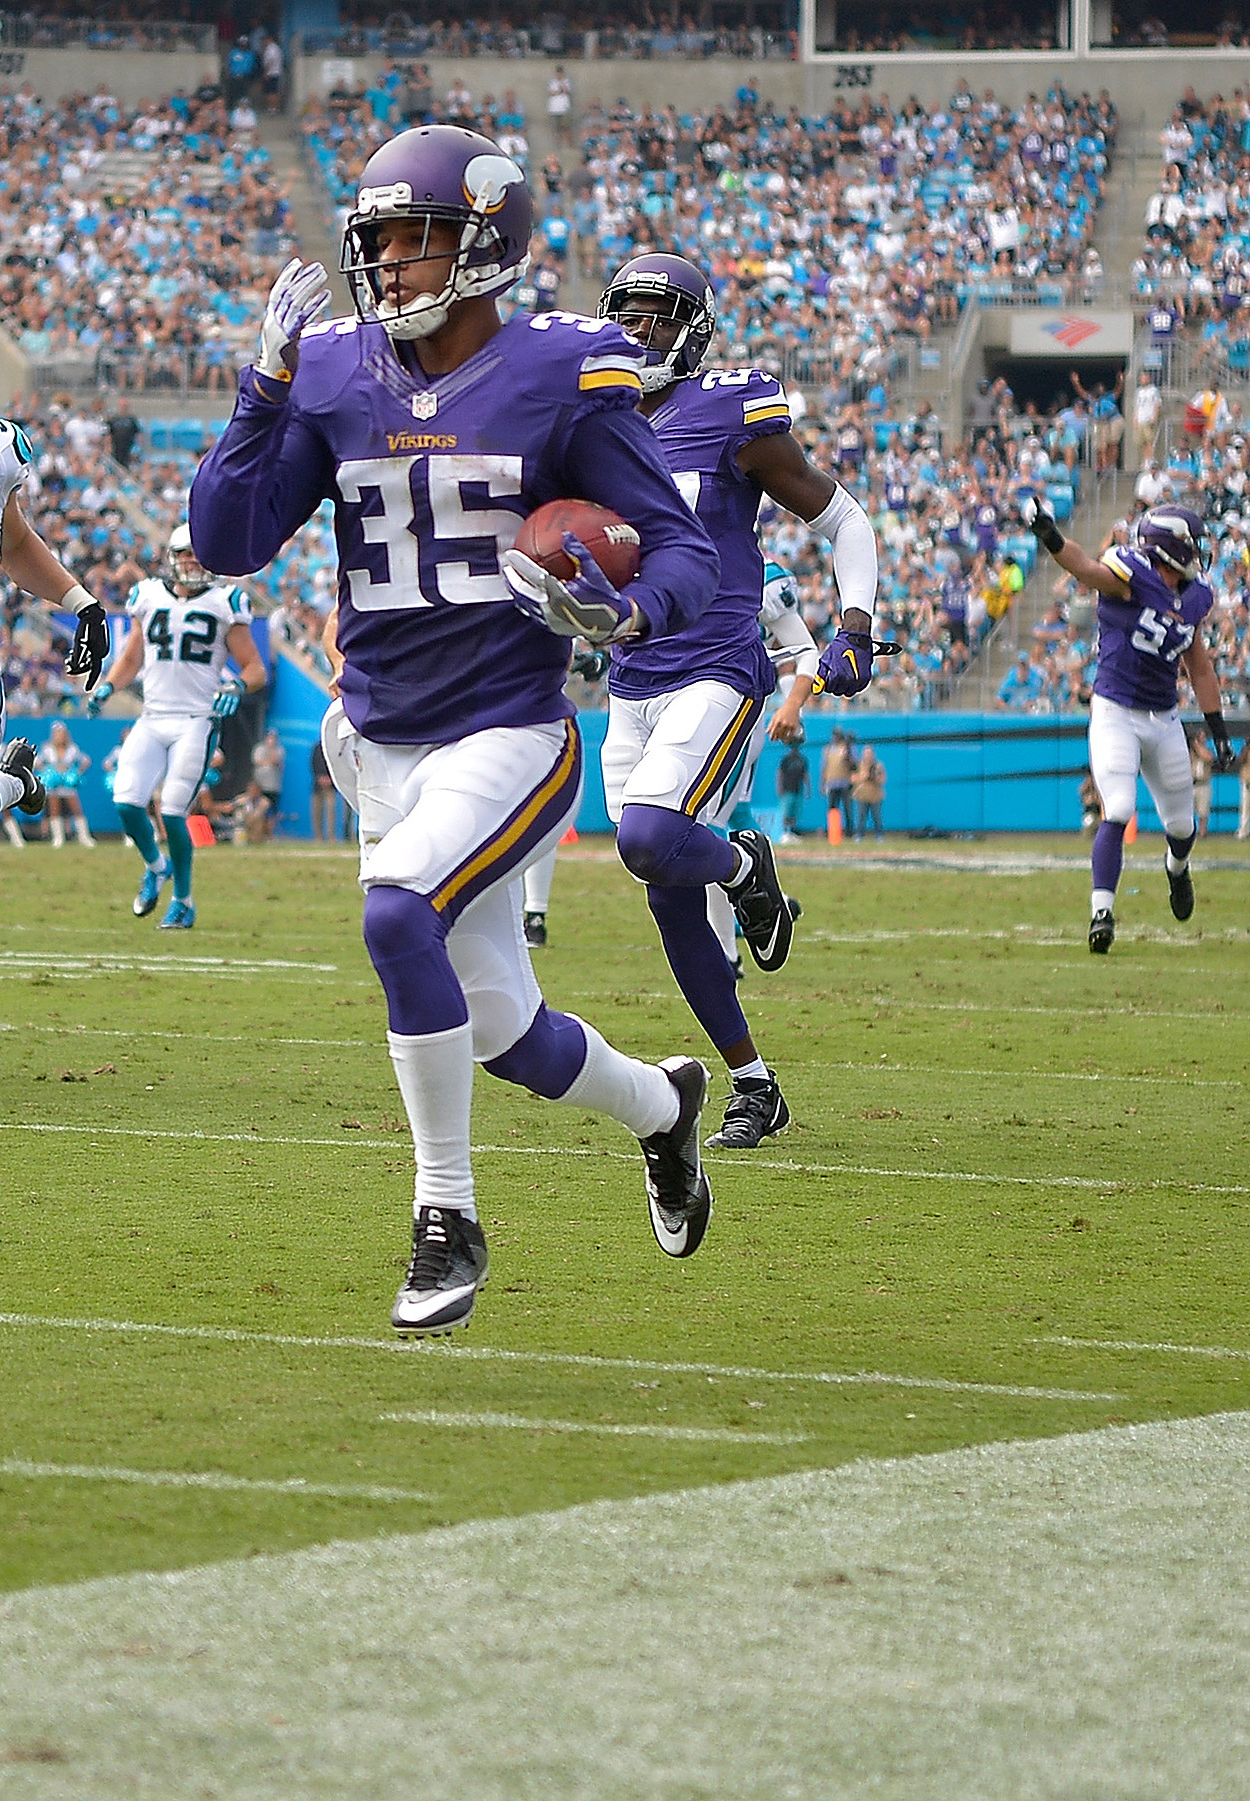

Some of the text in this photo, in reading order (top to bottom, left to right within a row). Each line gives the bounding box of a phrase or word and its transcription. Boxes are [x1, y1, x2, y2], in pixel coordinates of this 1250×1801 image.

[336, 455, 526, 612] 35
[147, 607, 218, 665] 42
[1131, 606, 1196, 662] 57
